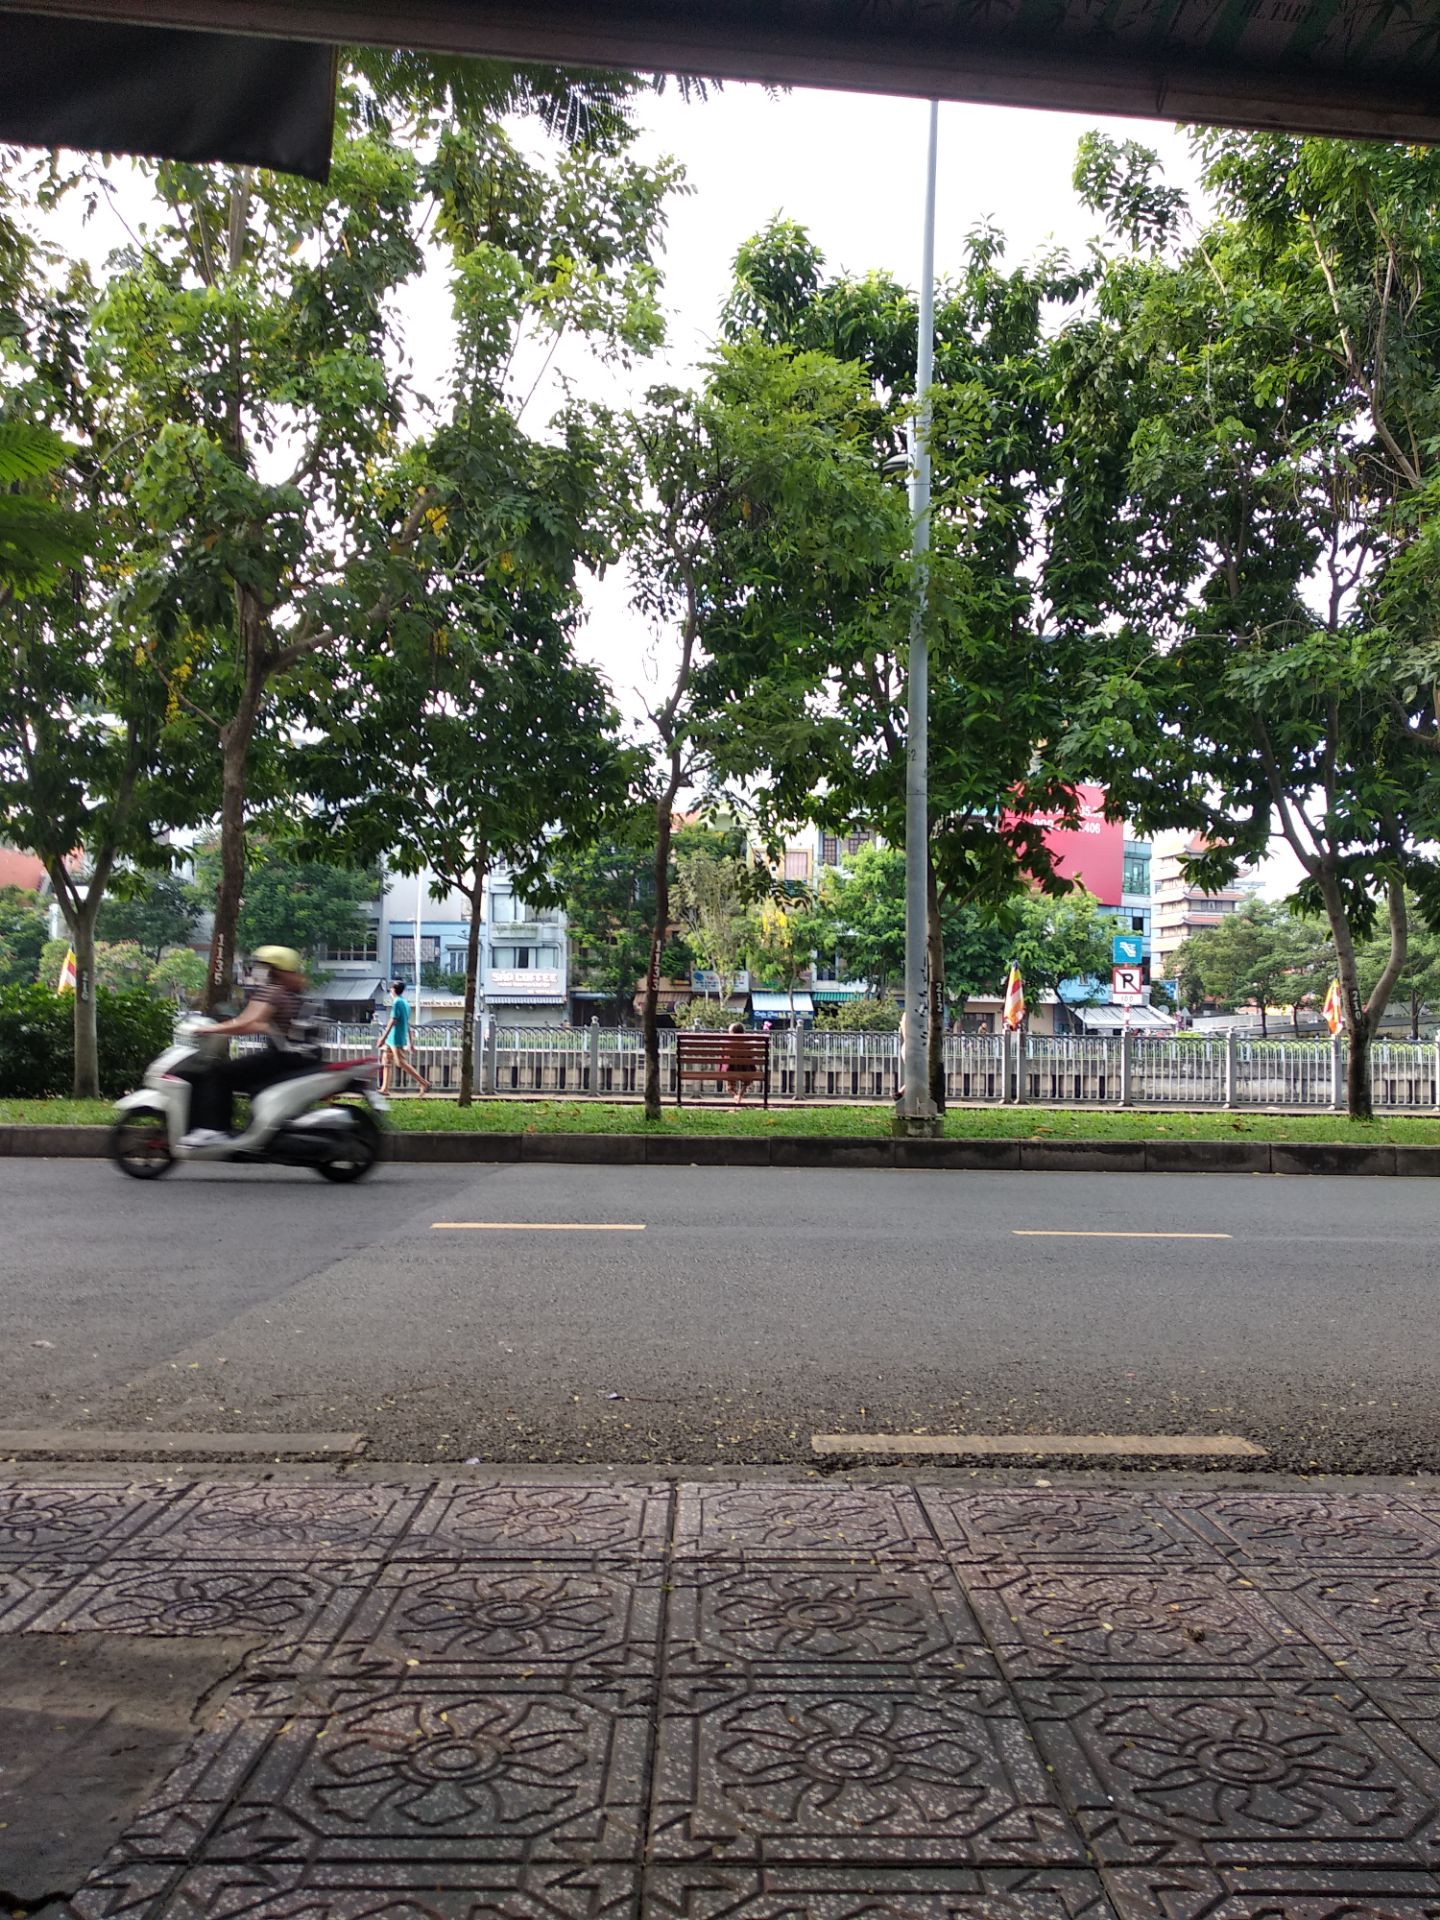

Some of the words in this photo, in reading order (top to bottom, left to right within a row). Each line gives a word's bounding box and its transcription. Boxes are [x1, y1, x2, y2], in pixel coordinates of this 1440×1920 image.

[214, 933, 225, 985] 1135
[651, 939, 662, 991] 1133
[515, 972, 558, 983] COFFEE
[935, 982, 943, 1012] 212
[1352, 990, 1362, 1020] 210
